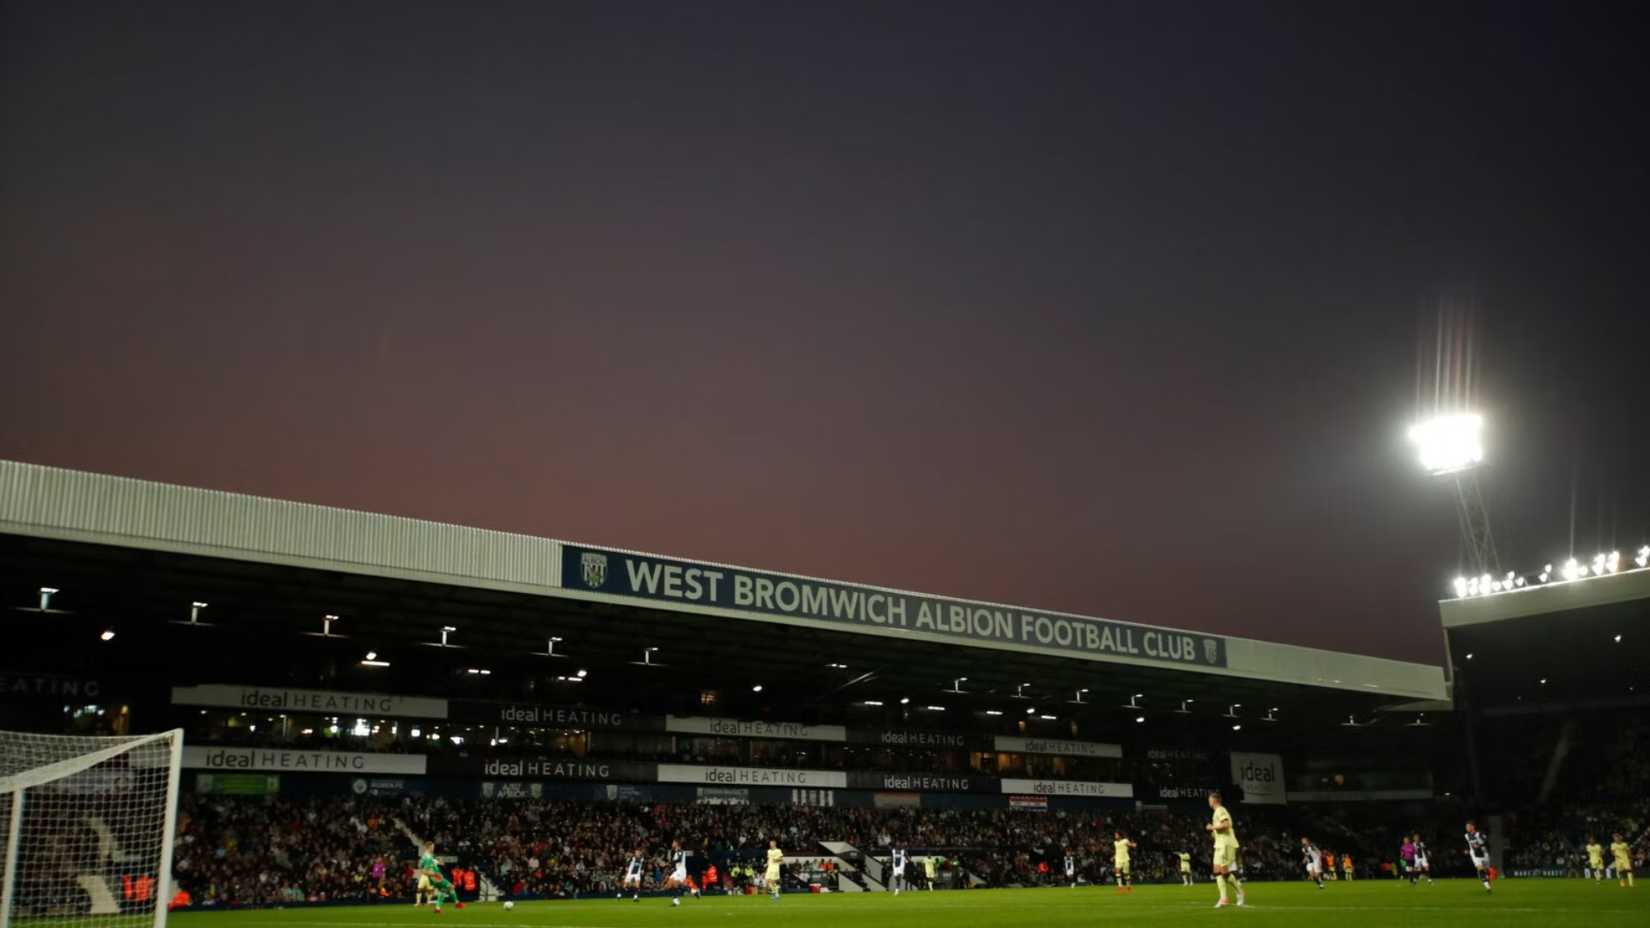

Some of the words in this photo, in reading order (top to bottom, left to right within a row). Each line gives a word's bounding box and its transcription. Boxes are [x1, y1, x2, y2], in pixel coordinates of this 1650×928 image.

[625, 559, 725, 602] WEST
[734, 574, 906, 627] BROMWICH
[916, 600, 1013, 639] ALBION
[1021, 615, 1139, 655] FOOTBALL
[1143, 631, 1196, 661] CLUB
[242, 690, 288, 707] ideal
[294, 692, 392, 712] HEATING
[501, 705, 539, 722] ideal
[544, 709, 622, 726] HEATING
[710, 717, 741, 734] ideal
[744, 721, 808, 736] HEATING
[909, 732, 965, 746] HEATING
[206, 750, 255, 768] ideal
[262, 753, 365, 769] HEATING
[485, 760, 523, 776] ideal
[528, 762, 610, 778] HEATING
[705, 768, 736, 783] ideal
[740, 770, 806, 784] HEATING
[1240, 761, 1275, 782] ideal
[884, 776, 911, 789] ideal
[913, 777, 969, 790] HEATING
